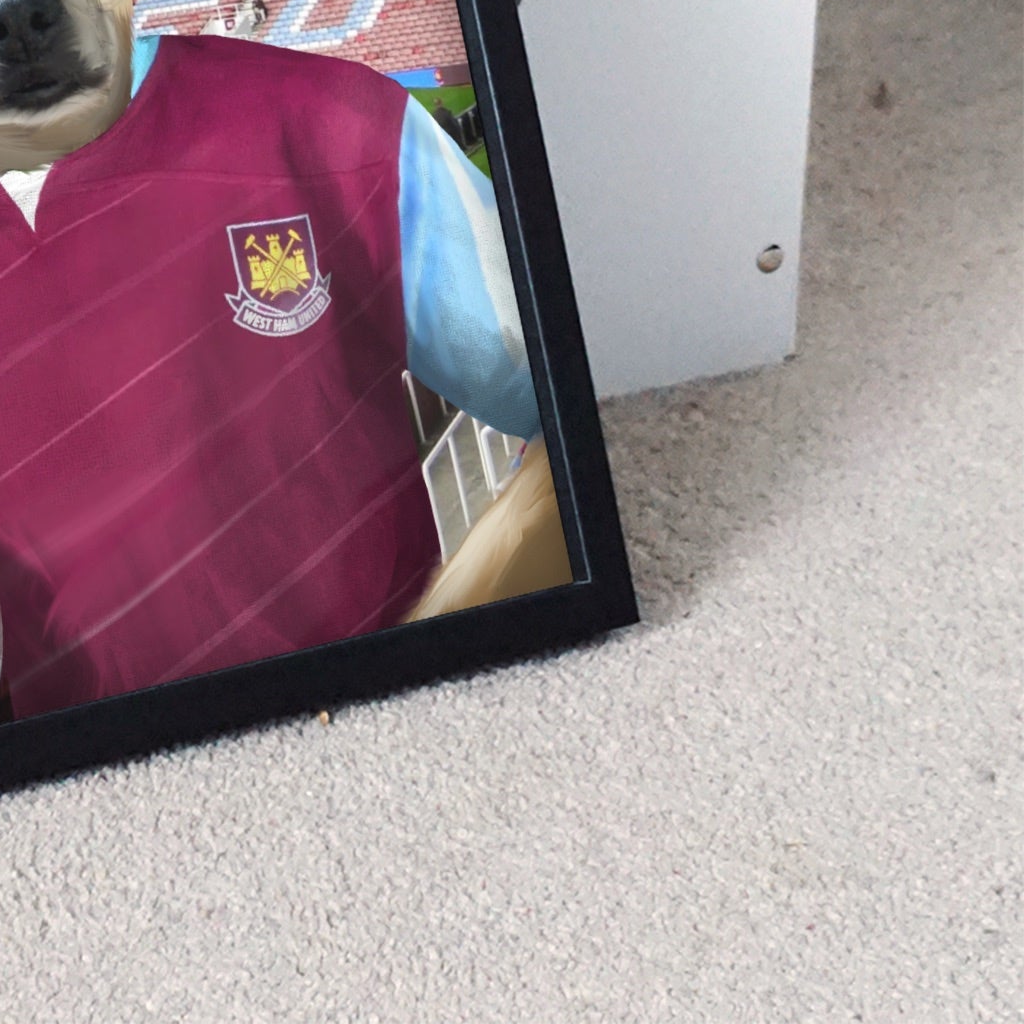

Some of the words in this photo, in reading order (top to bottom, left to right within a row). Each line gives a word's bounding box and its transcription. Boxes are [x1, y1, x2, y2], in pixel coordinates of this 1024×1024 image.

[242, 308, 273, 331] WEST
[272, 318, 296, 332] HAM
[297, 295, 326, 326] UNITED
